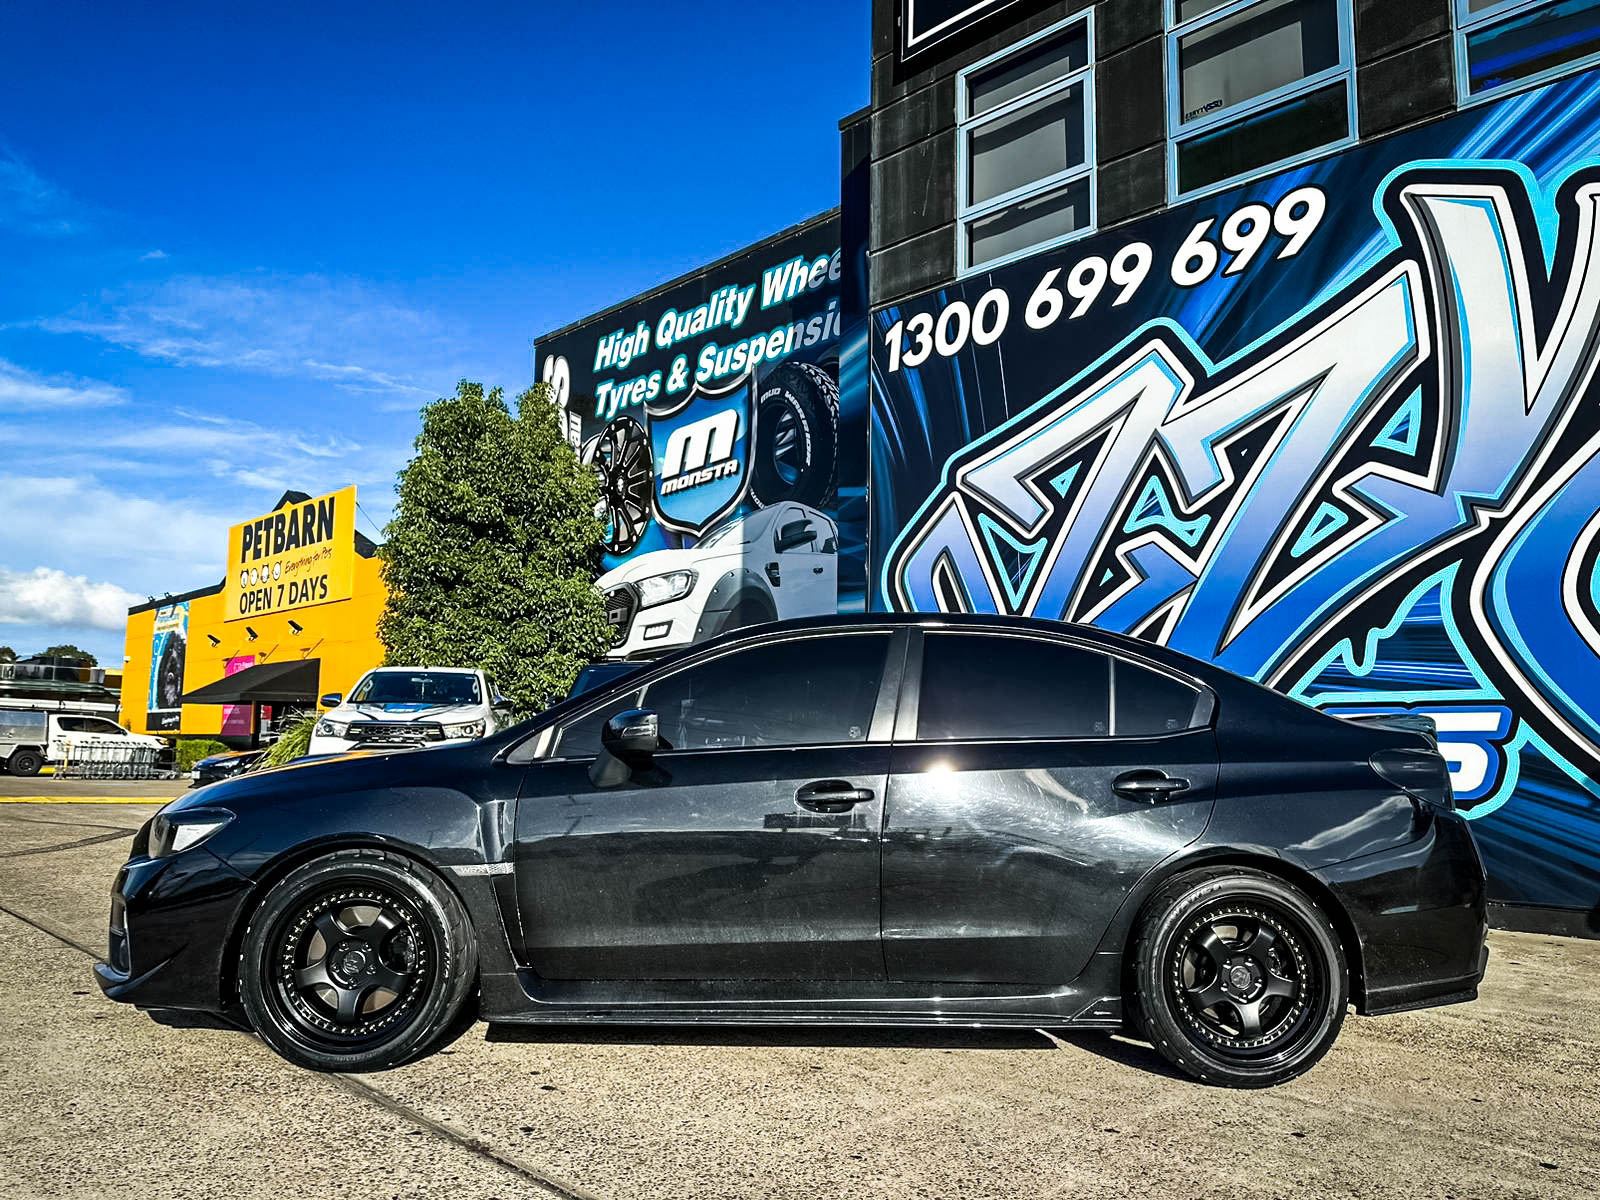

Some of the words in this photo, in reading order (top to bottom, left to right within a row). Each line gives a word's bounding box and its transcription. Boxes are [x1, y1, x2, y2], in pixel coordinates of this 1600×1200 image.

[884, 288, 1010, 373] 1300
[1024, 242, 1153, 330] 699
[1170, 186, 1326, 287] 699
[594, 322, 650, 370] High
[656, 285, 755, 347] Quality
[596, 371, 662, 418] Tyres
[667, 356, 688, 393] &
[241, 496, 335, 563] PETBARN
[240, 587, 272, 614] OPEN
[277, 584, 285, 607] 7
[288, 574, 328, 605] DAYS
